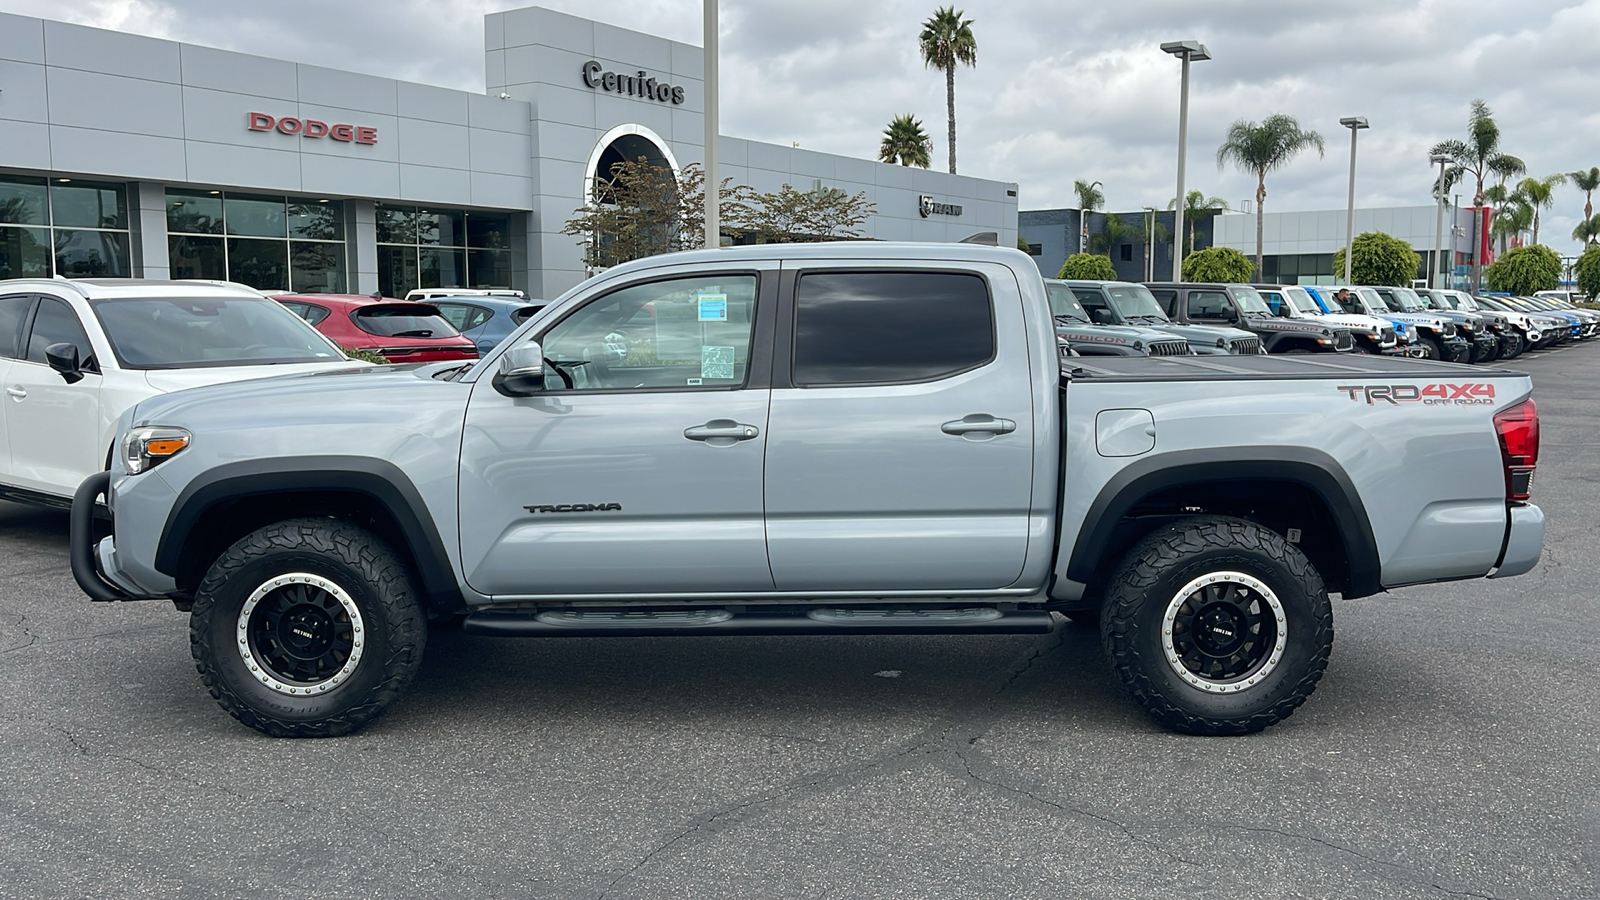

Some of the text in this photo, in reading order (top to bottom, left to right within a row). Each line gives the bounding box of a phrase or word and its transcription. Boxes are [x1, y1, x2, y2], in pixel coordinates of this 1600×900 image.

[581, 60, 685, 105] Cerritos
[246, 111, 378, 145] DODGE
[932, 203, 962, 216] RAM
[1057, 333, 1127, 344] RUBICON
[1337, 385, 1422, 406] TRD
[1423, 398, 1495, 406] OFF ROAD
[522, 503, 622, 513] TACOMA
